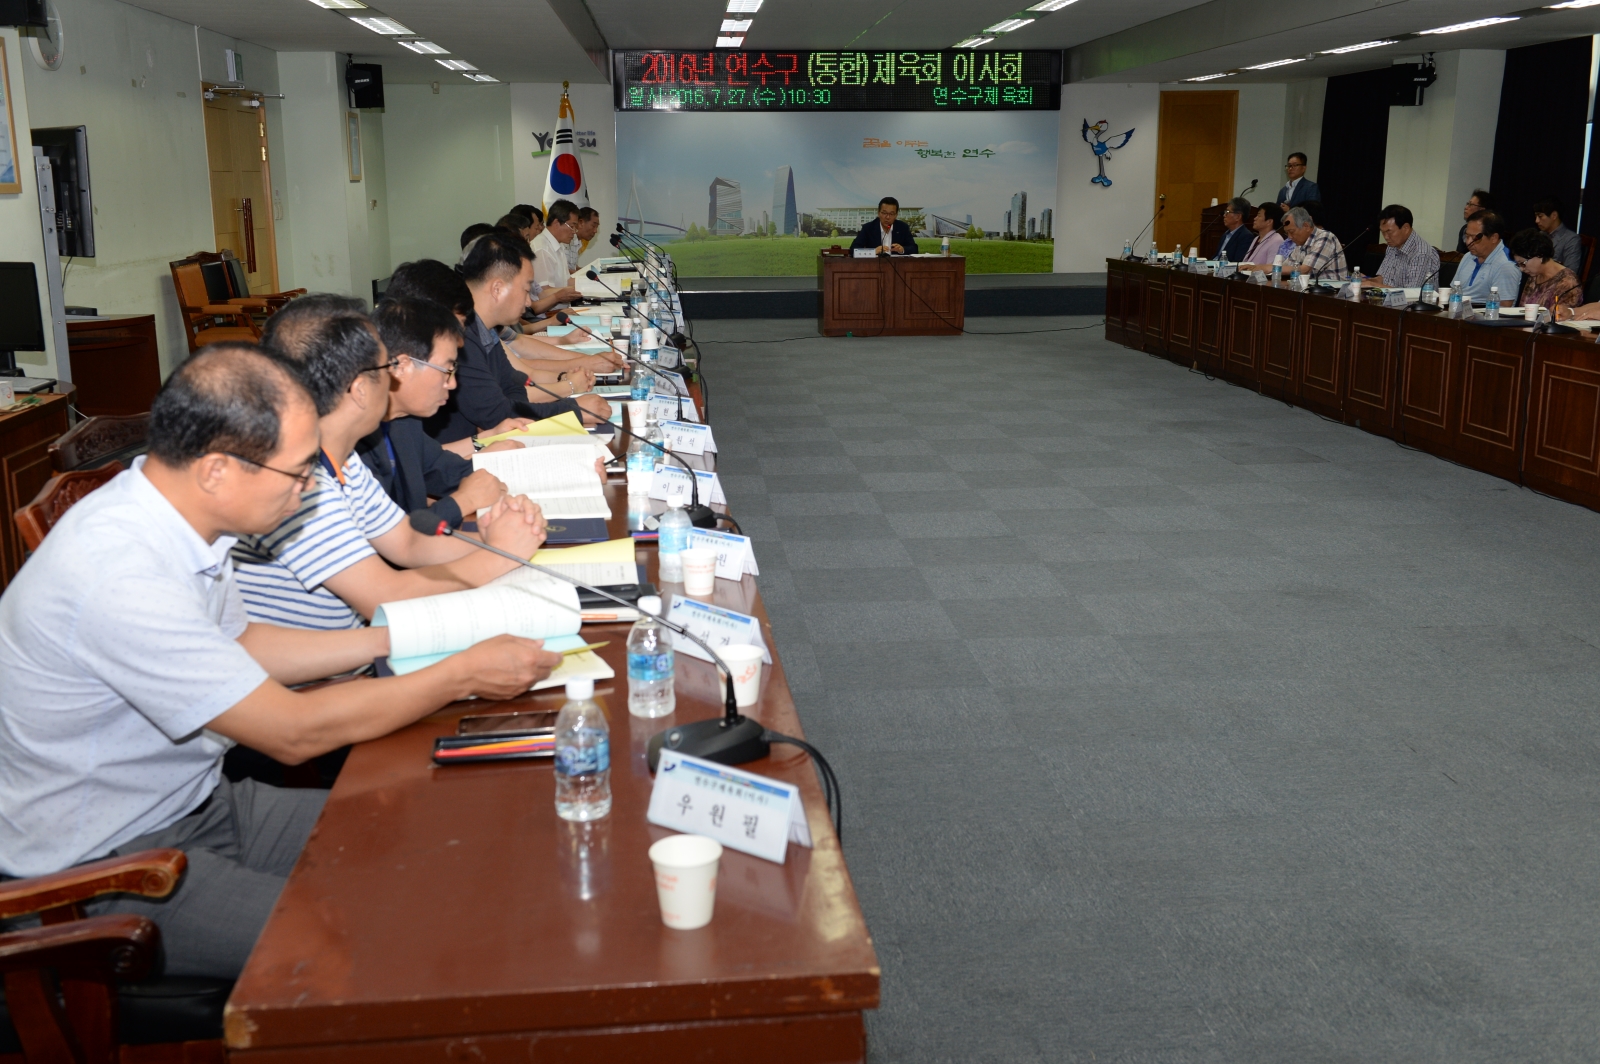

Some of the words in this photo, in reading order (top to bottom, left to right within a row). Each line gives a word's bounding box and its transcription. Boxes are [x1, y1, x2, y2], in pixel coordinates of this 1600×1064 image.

[641, 51, 716, 85] 2016년
[725, 51, 799, 86] 연수구
[953, 51, 1023, 86] 이사회
[914, 148, 956, 159] 행복한
[962, 148, 996, 159] 연수
